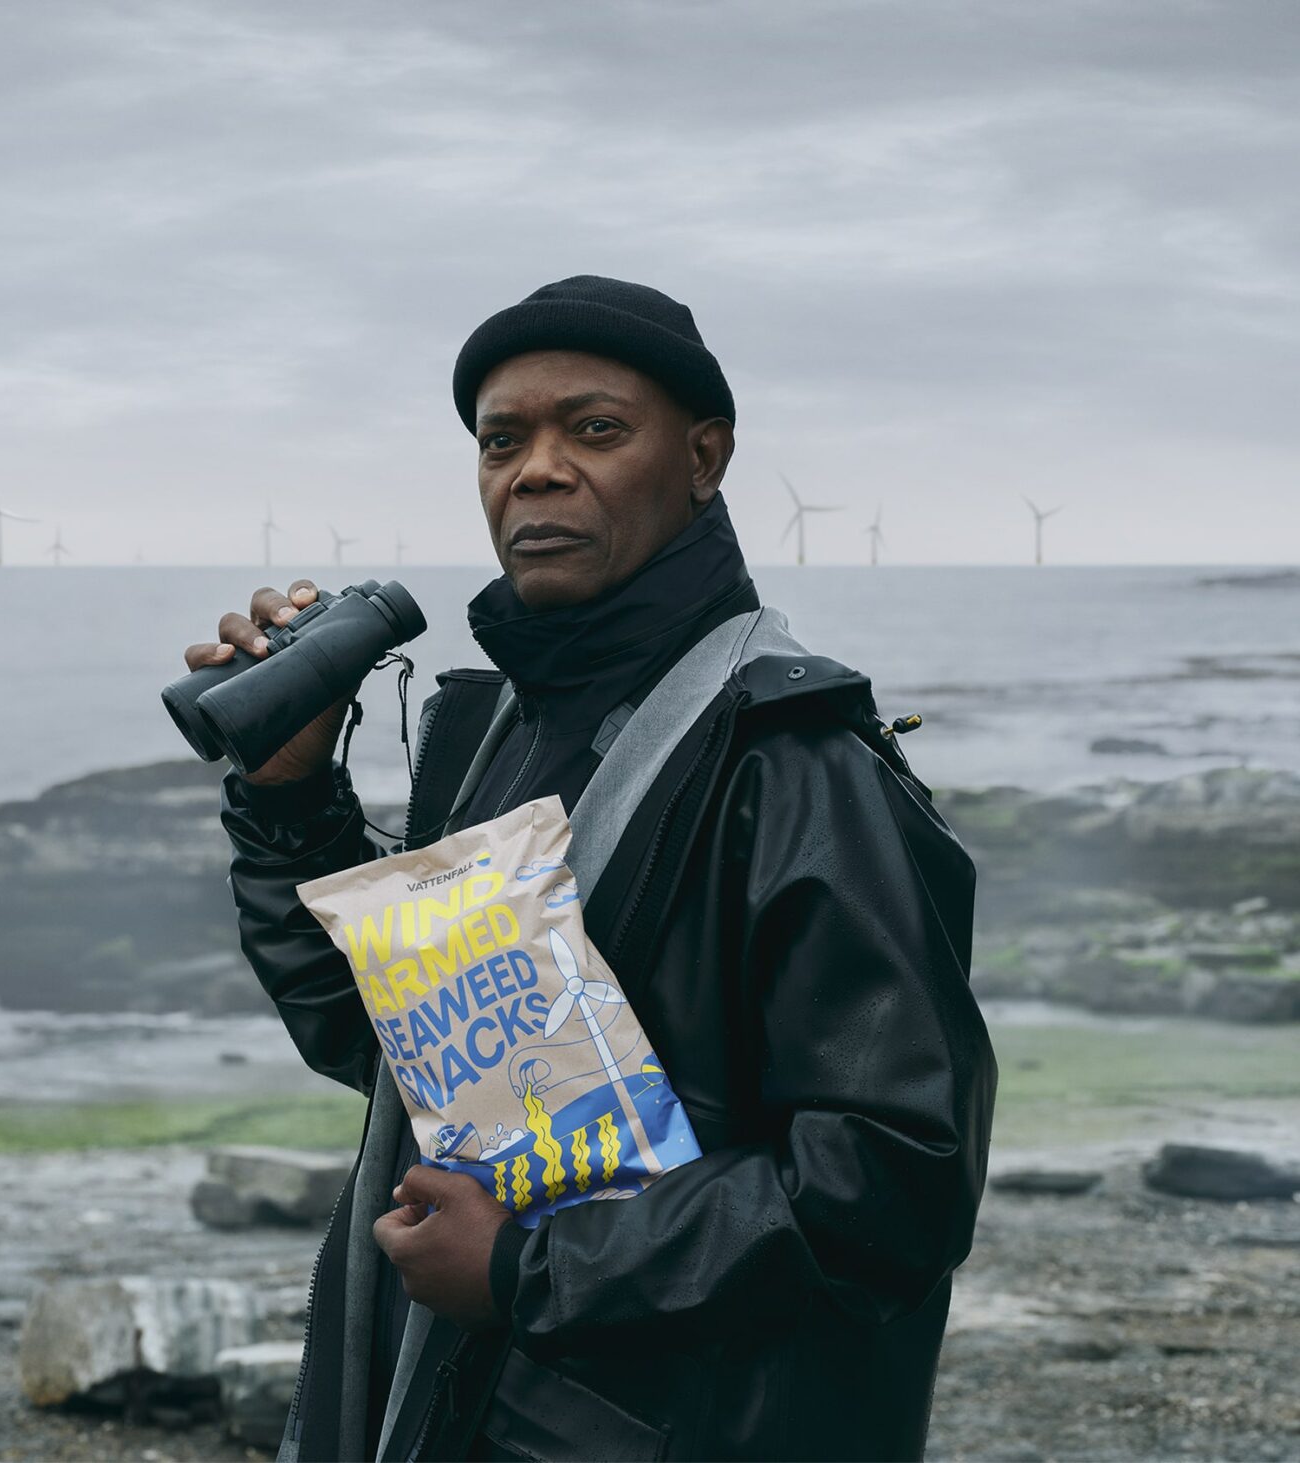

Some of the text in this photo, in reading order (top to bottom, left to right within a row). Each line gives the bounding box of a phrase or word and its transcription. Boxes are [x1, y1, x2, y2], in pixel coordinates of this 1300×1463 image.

[344, 872, 505, 971] WIND
[407, 862, 474, 892] VATTENFALL
[375, 950, 538, 1060] SEAWEED
[396, 992, 549, 1112] SNACKS
